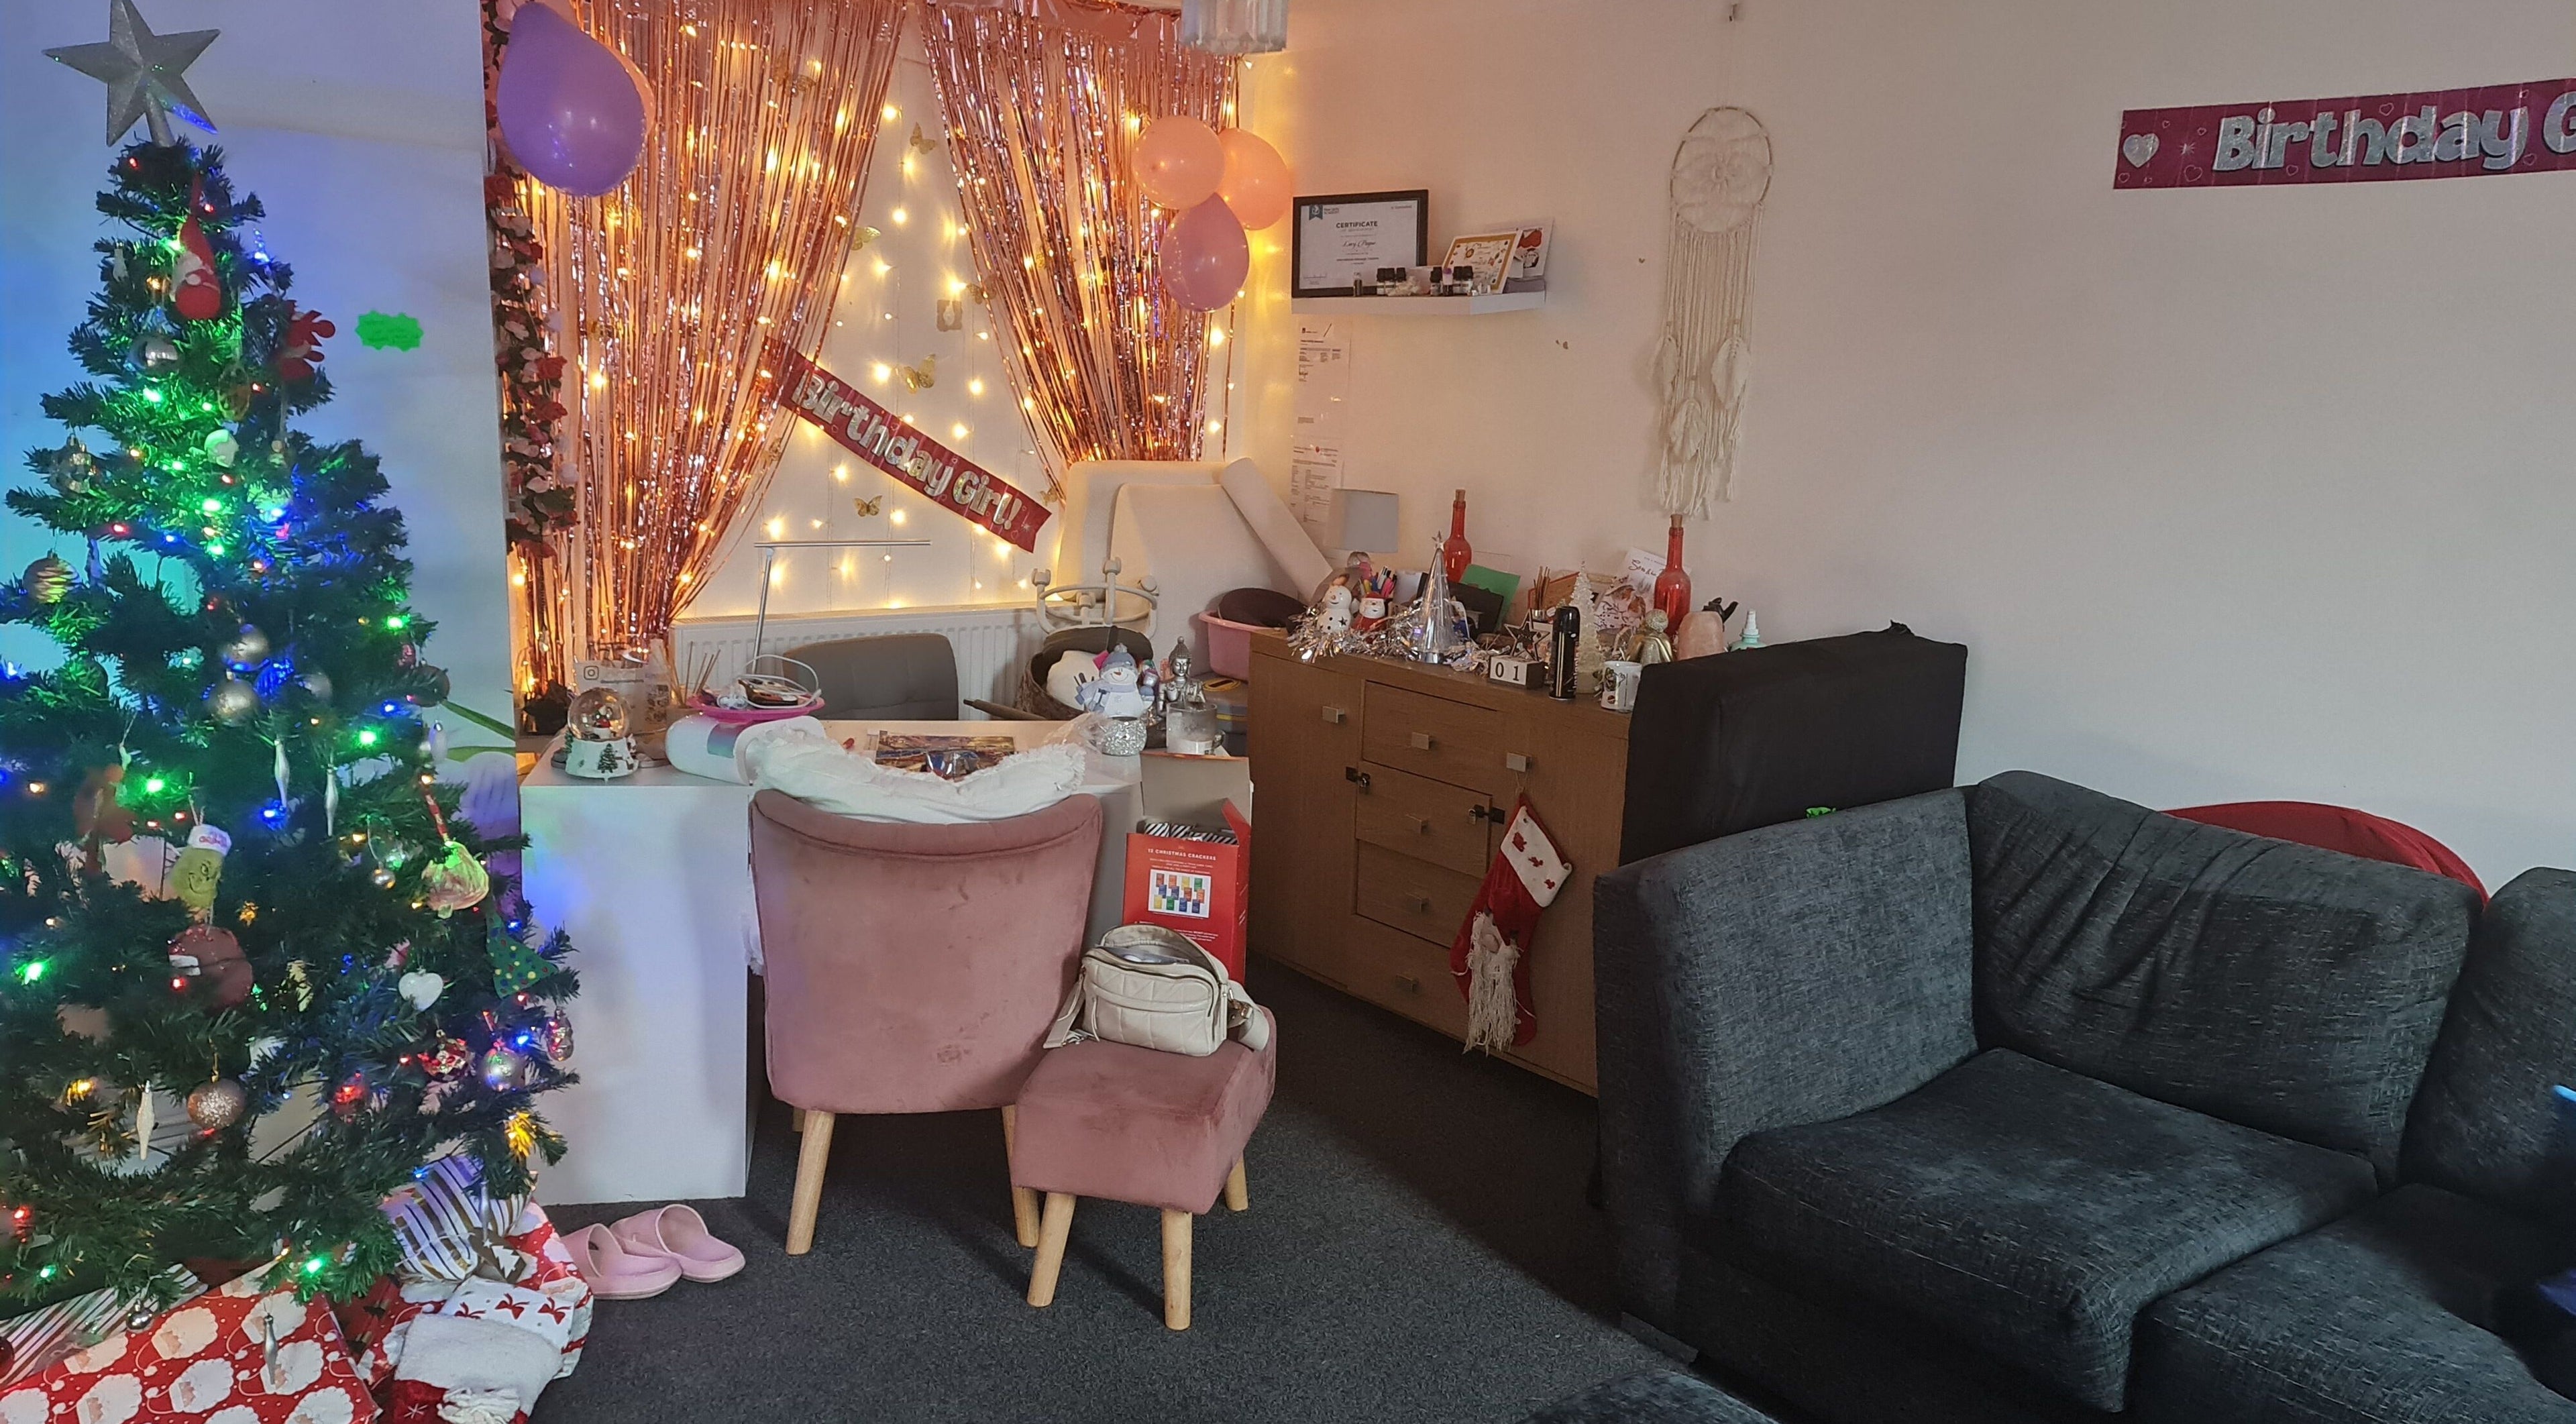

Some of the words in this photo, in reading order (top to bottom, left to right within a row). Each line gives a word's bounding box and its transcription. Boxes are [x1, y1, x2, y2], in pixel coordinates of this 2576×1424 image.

[2212, 105, 2529, 171] Birthday
[1336, 221, 1378, 229] CERTIFICATE
[792, 369, 954, 497] Birthday
[953, 471, 1022, 530] Girl!
[1155, 849, 1187, 857] CHRISTMAS
[1188, 853, 1216, 861] CRACKERS
